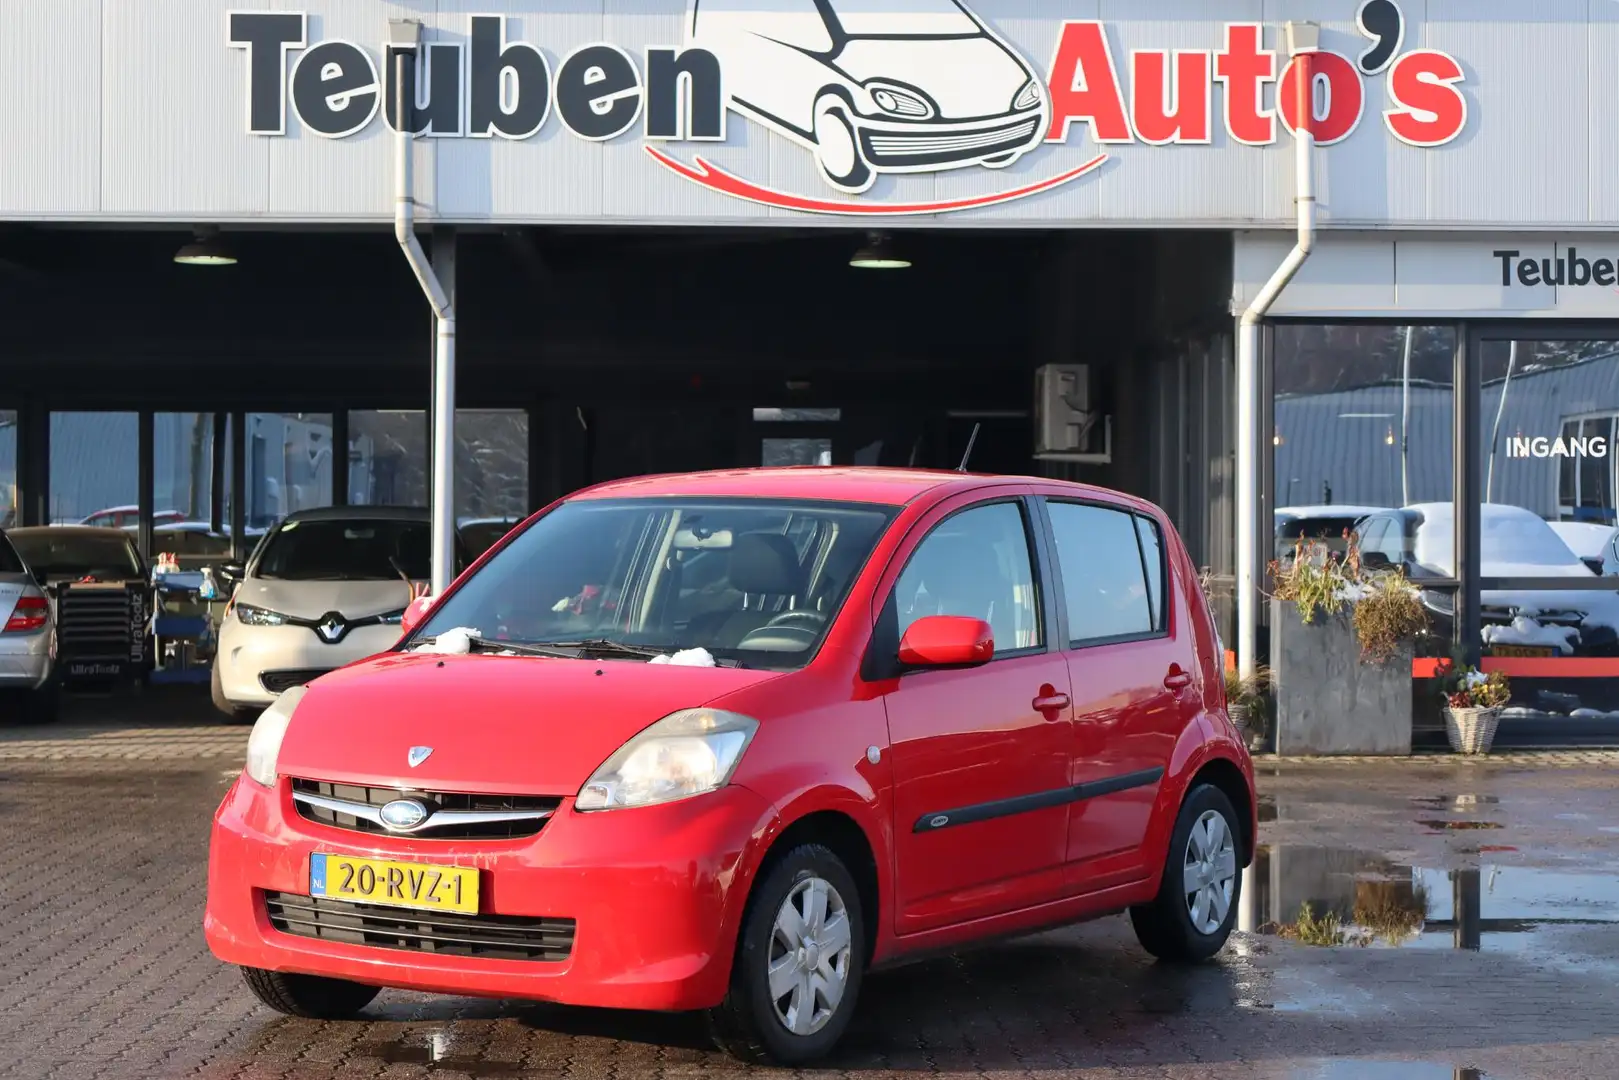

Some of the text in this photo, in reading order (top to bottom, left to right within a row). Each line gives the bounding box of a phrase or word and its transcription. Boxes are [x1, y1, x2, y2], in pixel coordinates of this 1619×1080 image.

[227, 0, 1468, 146] Teuben Auto's
[1493, 247, 1619, 287] Teube
[1506, 436, 1607, 458] INGANG
[312, 878, 325, 889] NL
[338, 863, 462, 905] 20-RVZ-1
